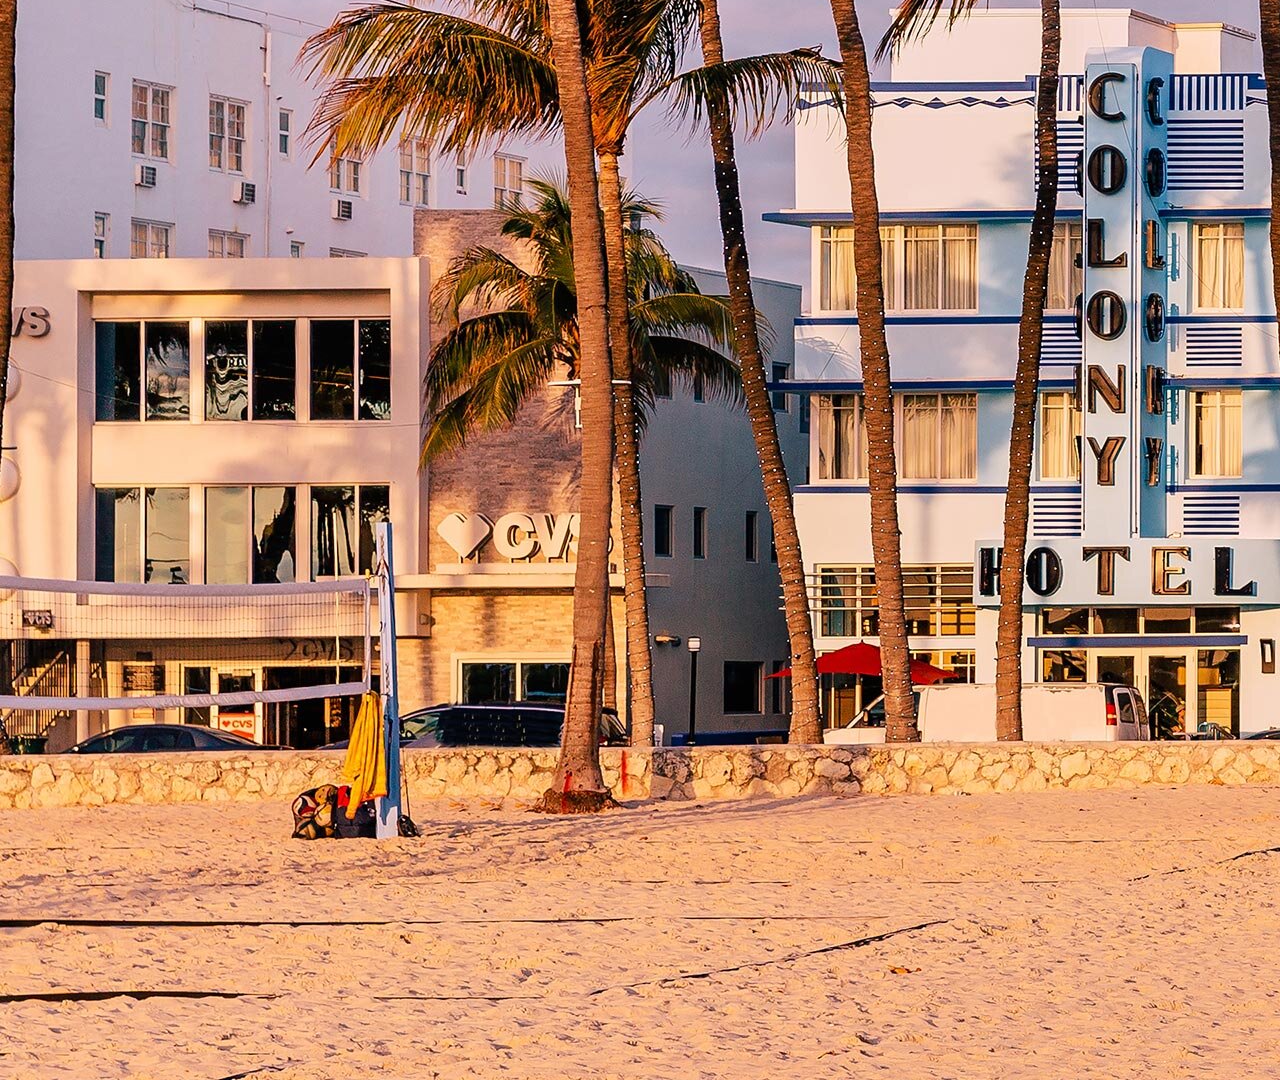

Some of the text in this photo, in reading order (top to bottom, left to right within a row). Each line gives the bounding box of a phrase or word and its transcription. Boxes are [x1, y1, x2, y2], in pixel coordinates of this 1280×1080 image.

[1087, 72, 1128, 487] COLONY
[979, 546, 1257, 597] HOTEL
[232, 720, 253, 728] CVS
